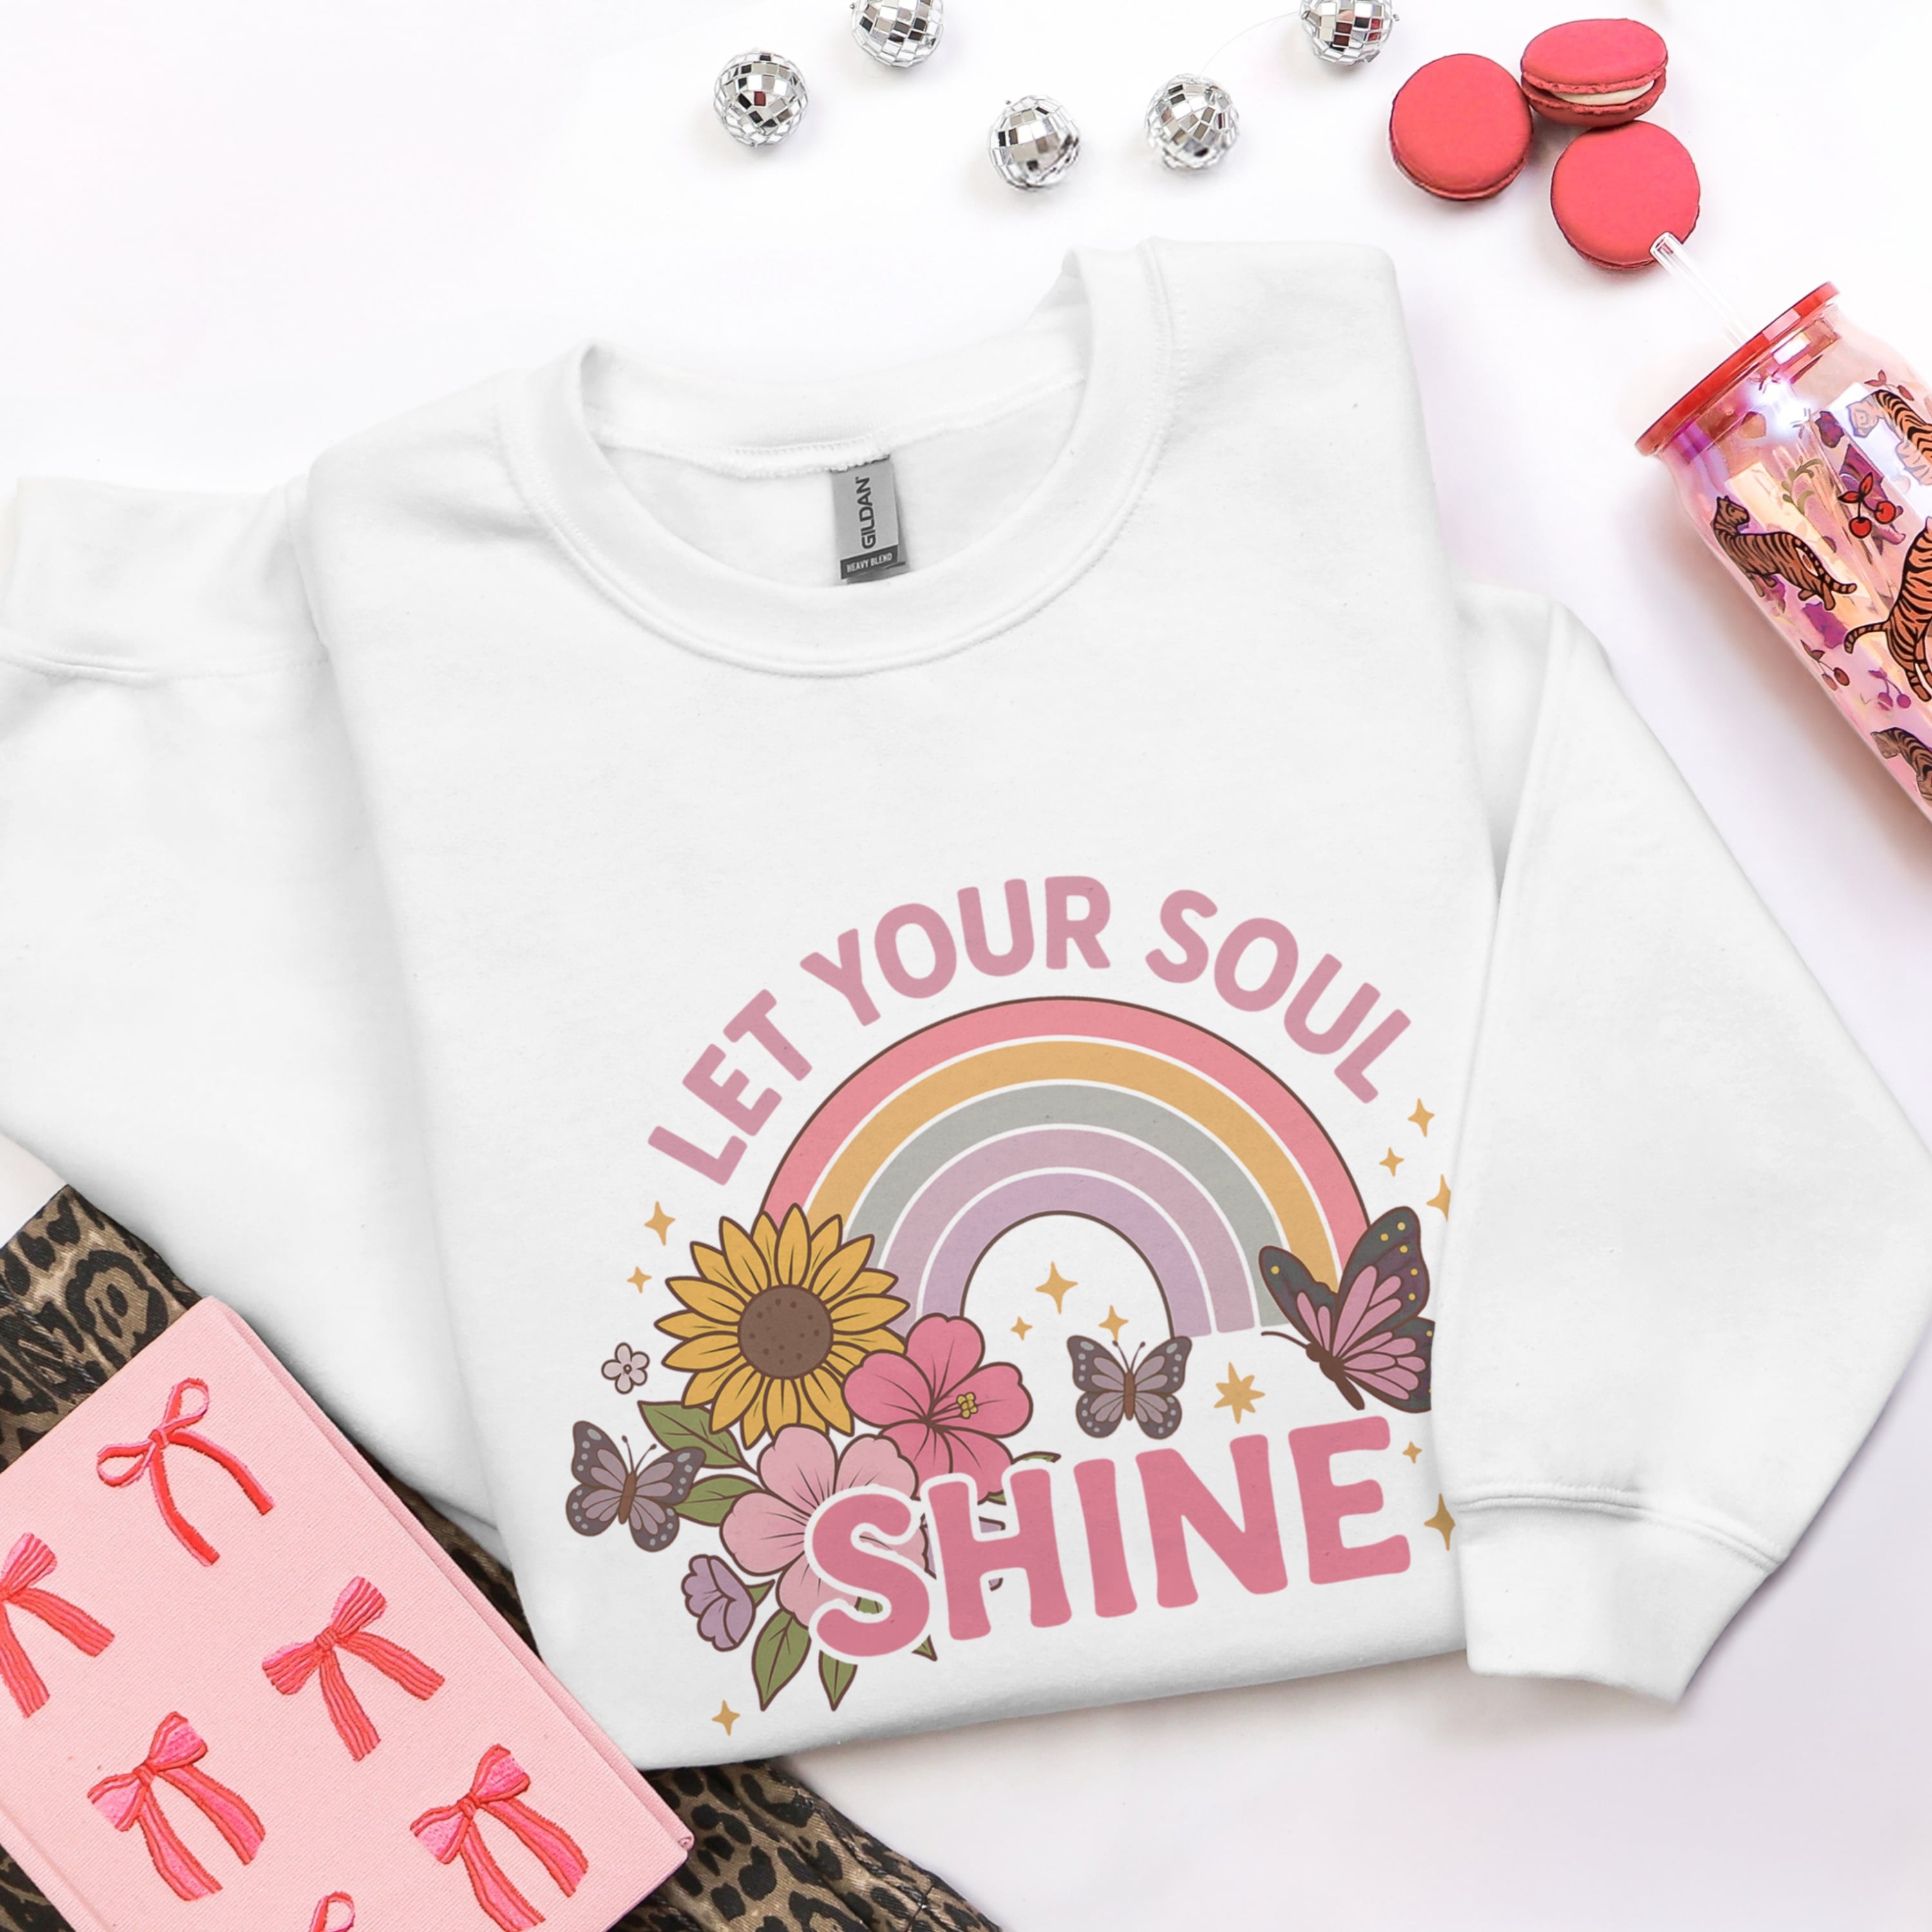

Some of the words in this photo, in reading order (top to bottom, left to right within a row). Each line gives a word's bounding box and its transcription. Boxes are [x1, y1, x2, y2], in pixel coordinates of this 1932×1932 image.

[846, 560, 869, 573] HEAVY
[871, 553, 893, 566] BLEND
[855, 477, 876, 549] GILDAN
[648, 989, 812, 1185] LET
[800, 876, 1112, 1026] YOUR
[1145, 889, 1412, 1103] SOUL
[811, 1416, 1411, 1657] SHINE
